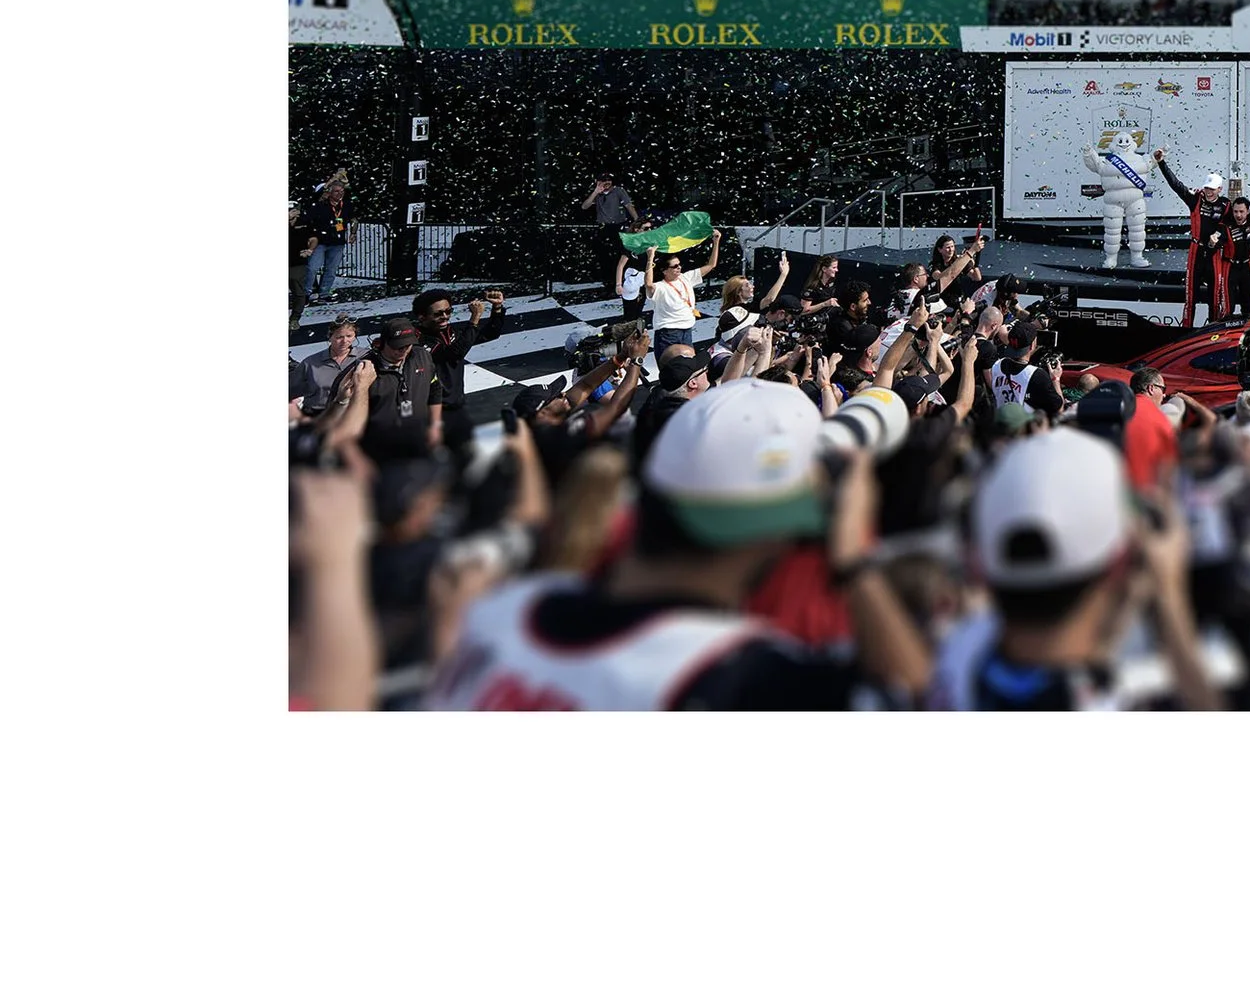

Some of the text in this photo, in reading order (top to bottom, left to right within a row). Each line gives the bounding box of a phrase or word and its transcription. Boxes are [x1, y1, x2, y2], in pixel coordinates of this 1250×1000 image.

[467, 22, 579, 46] ROLEX
[649, 22, 762, 46] ROLEX
[834, 22, 950, 46] ROLEX
[1009, 32, 1055, 47] Mobil
[1096, 34, 1153, 46] VICTORY
[1156, 34, 1191, 46] LANE
[1103, 120, 1140, 128] ROLEX
[1110, 156, 1145, 188] MICHELIN
